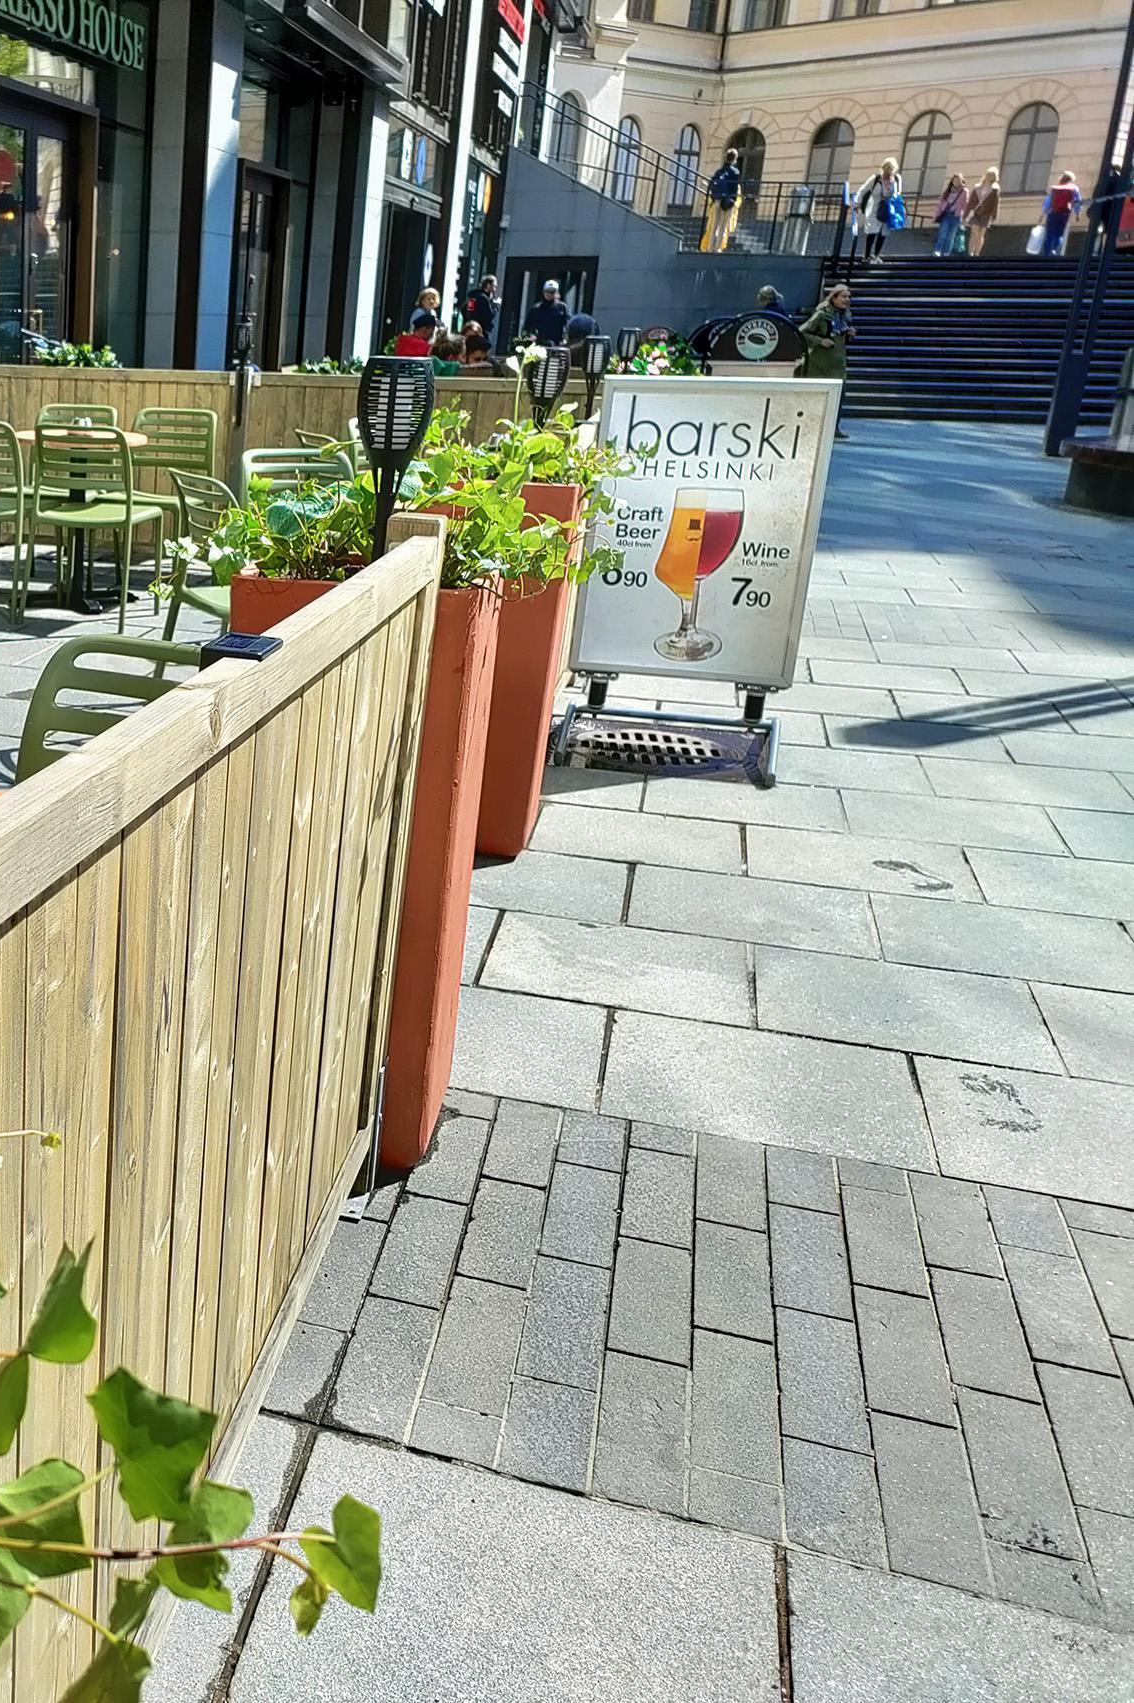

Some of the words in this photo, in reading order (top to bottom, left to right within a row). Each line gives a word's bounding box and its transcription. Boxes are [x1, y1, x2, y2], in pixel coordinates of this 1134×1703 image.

[79, 0, 145, 71] HOUSE
[626, 395, 805, 460] barski
[642, 460, 774, 481] HELSINKI
[617, 505, 664, 521] Craft
[615, 523, 661, 539] Beer
[742, 542, 790, 559] Wine
